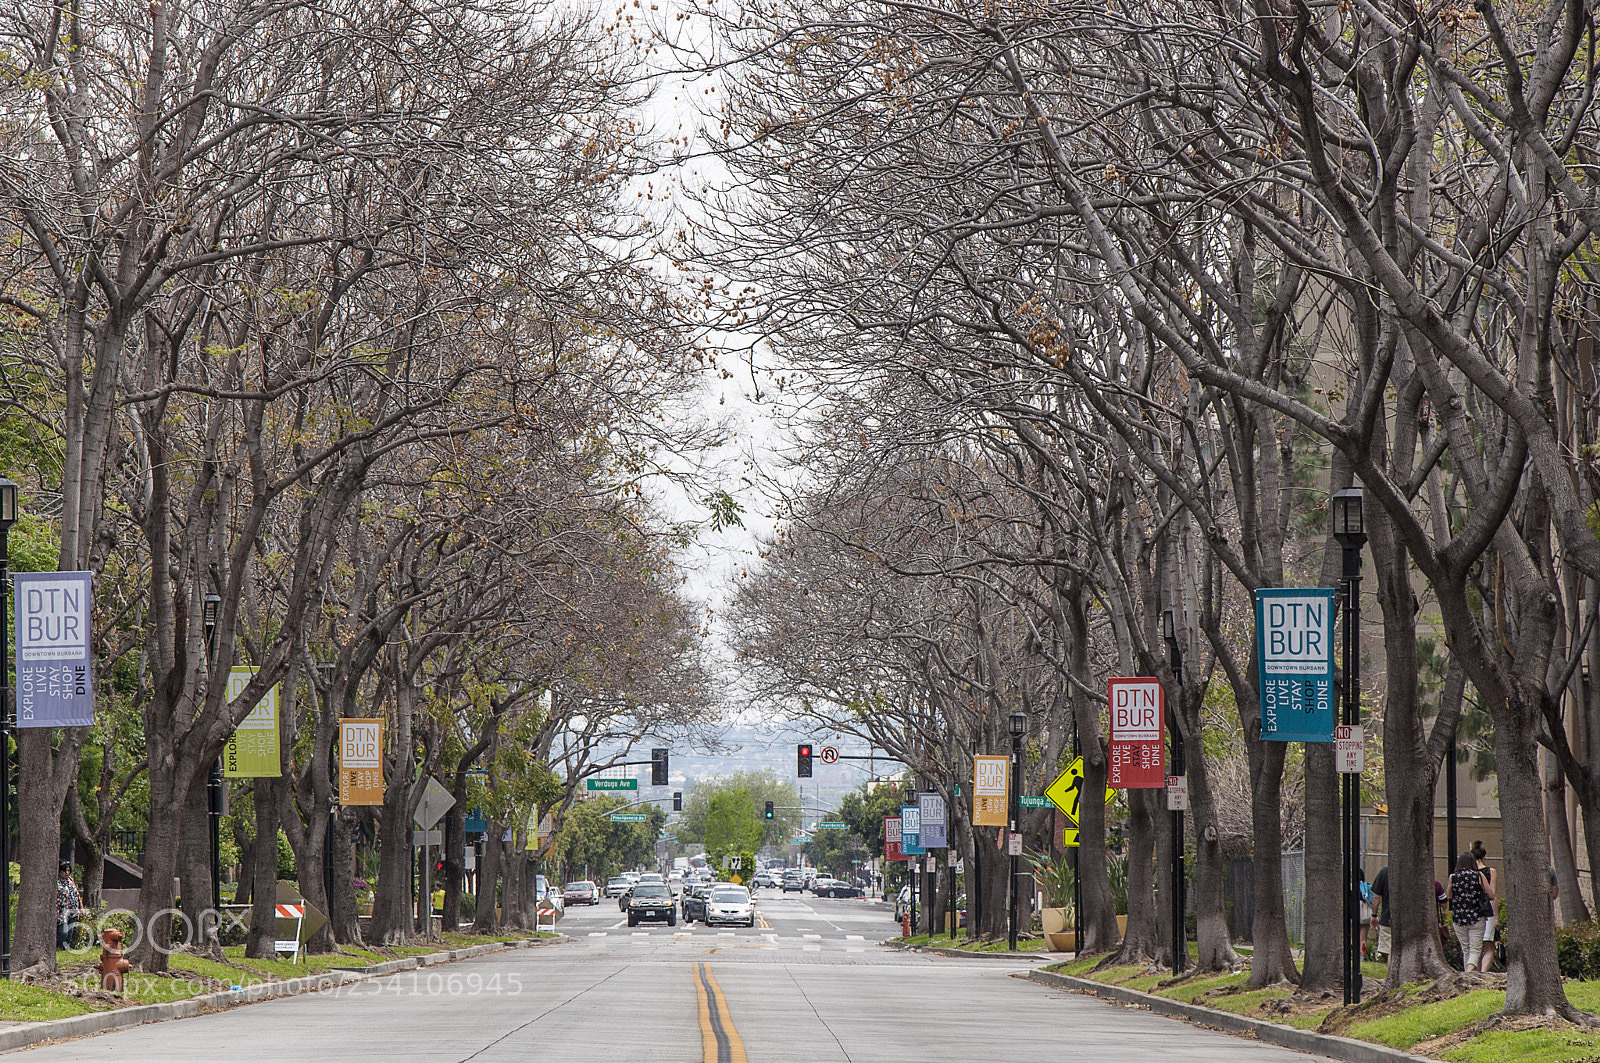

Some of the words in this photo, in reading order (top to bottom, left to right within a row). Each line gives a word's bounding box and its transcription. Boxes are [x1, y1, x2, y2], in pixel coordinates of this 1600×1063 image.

[27, 588, 79, 614] DTN
[1270, 603, 1322, 628] DTN
[28, 615, 79, 642] BUR
[1270, 630, 1322, 655] BUR
[36, 666, 46, 693] LIVE
[50, 666, 60, 697] STAY
[62, 665, 73, 700] SHOP
[76, 665, 86, 695] DINE
[22, 666, 34, 720] EXPLORE
[1116, 689, 1154, 708] DTN
[1278, 679, 1289, 706] LIVE
[1292, 680, 1302, 710] STAY
[1304, 680, 1314, 714] SHOP
[1317, 680, 1328, 710] DINE
[1117, 708, 1154, 727] BUR
[1266, 679, 1277, 732] EXPLORE
[238, 732, 246, 752] LIVE
[248, 732, 256, 754] STAY
[258, 732, 266, 757] SHOP
[267, 732, 275, 754] DINE
[346, 728, 376, 742] DTN
[1338, 728, 1349, 738] NO
[1338, 741, 1362, 750] STOPPING
[228, 732, 237, 772] EXPLORE
[346, 744, 376, 758] BUR
[1112, 744, 1120, 783] EXPLORE
[1122, 744, 1130, 764] LIVE
[1142, 744, 1150, 769] SHOP
[1152, 744, 1160, 766] DINE
[980, 763, 1004, 775] DTN
[980, 776, 1003, 788] BUR
[923, 798, 943, 808] DTN
[923, 809, 942, 818] BUR
[1021, 796, 1044, 807] Tujunga
